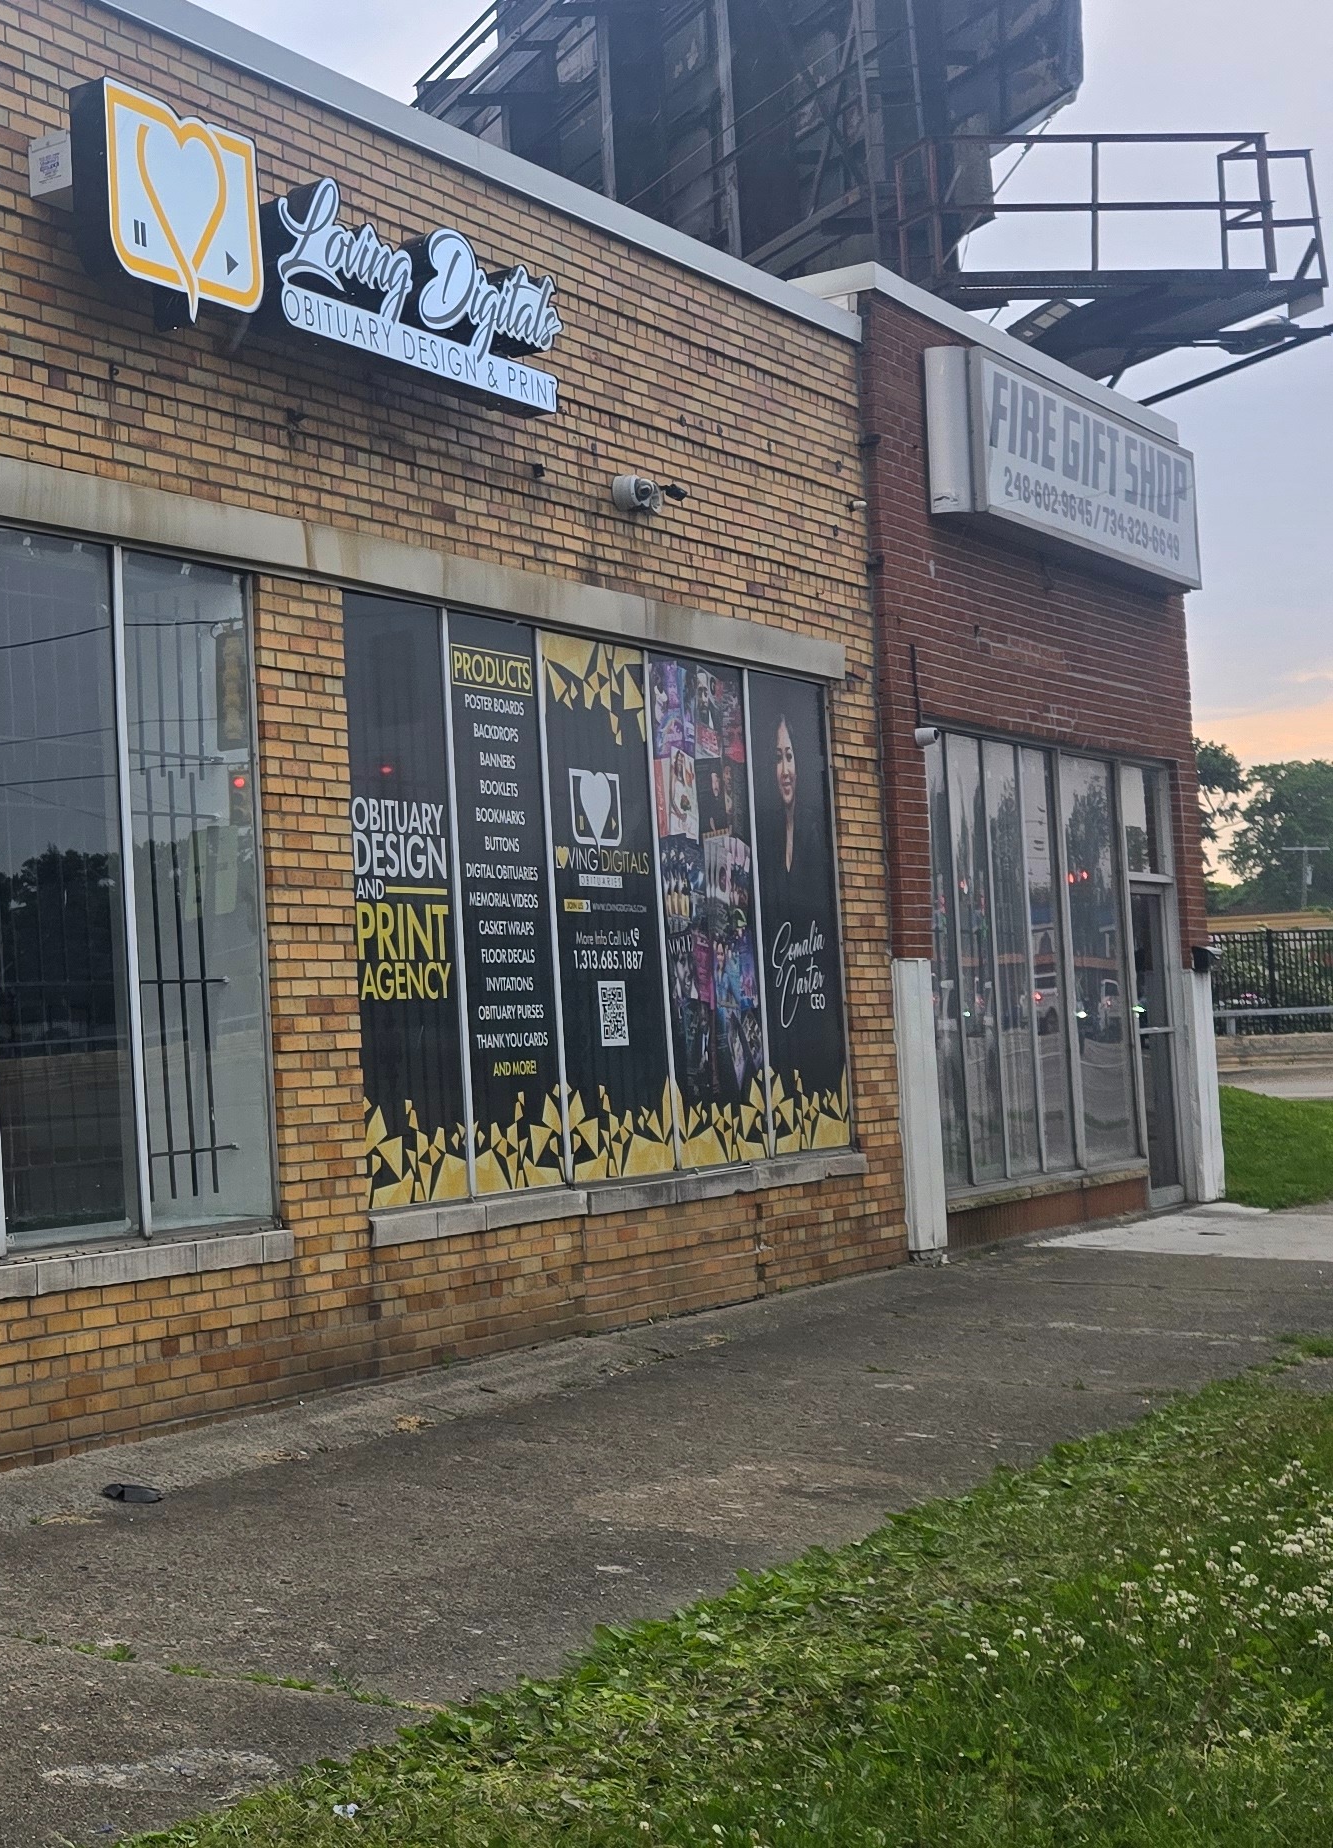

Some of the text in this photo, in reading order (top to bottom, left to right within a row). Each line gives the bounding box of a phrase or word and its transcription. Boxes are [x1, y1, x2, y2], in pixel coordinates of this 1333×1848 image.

[279, 181, 561, 363] Loving Digitals
[284, 289, 556, 405] OBITUARY DESIGN & PRINT
[989, 370, 1187, 524] FIRE GIFT SHOP
[453, 650, 531, 690] PRODUCTS
[464, 693, 524, 716] POSTER BOARDS
[473, 722, 519, 742] BACKDROPS
[479, 751, 516, 769] BANNERS
[479, 779, 519, 797] BOOKLETS
[352, 796, 444, 836] OBITUARY
[475, 807, 526, 825] BOOKMARKS
[484, 836, 520, 852] BUTTONS
[353, 831, 448, 879] DESIGN
[600, 849, 650, 875] DIGITALS
[465, 862, 539, 881] DIGITAL OBITUARIES
[356, 878, 385, 900] AND
[580, 875, 622, 887] OBITUARIES
[469, 891, 539, 908] MEMORIAL VIDEOS
[356, 902, 449, 961] PRINT
[478, 920, 535, 936] CASKET WRAPS
[576, 931, 594, 945] More
[608, 930, 622, 945] Call
[622, 931, 631, 946] Us
[481, 948, 536, 964] FLOOR DECALS
[573, 949, 644, 970] 1.313.685.1887
[361, 961, 451, 1001] AGENCY
[486, 976, 534, 992] INVITATIONS
[810, 993, 826, 1010] CEO
[478, 1004, 544, 1020] OBITUARY PURSES
[476, 1031, 549, 1049] THANK YOU CARDS
[493, 1060, 537, 1077] AND MORE!
